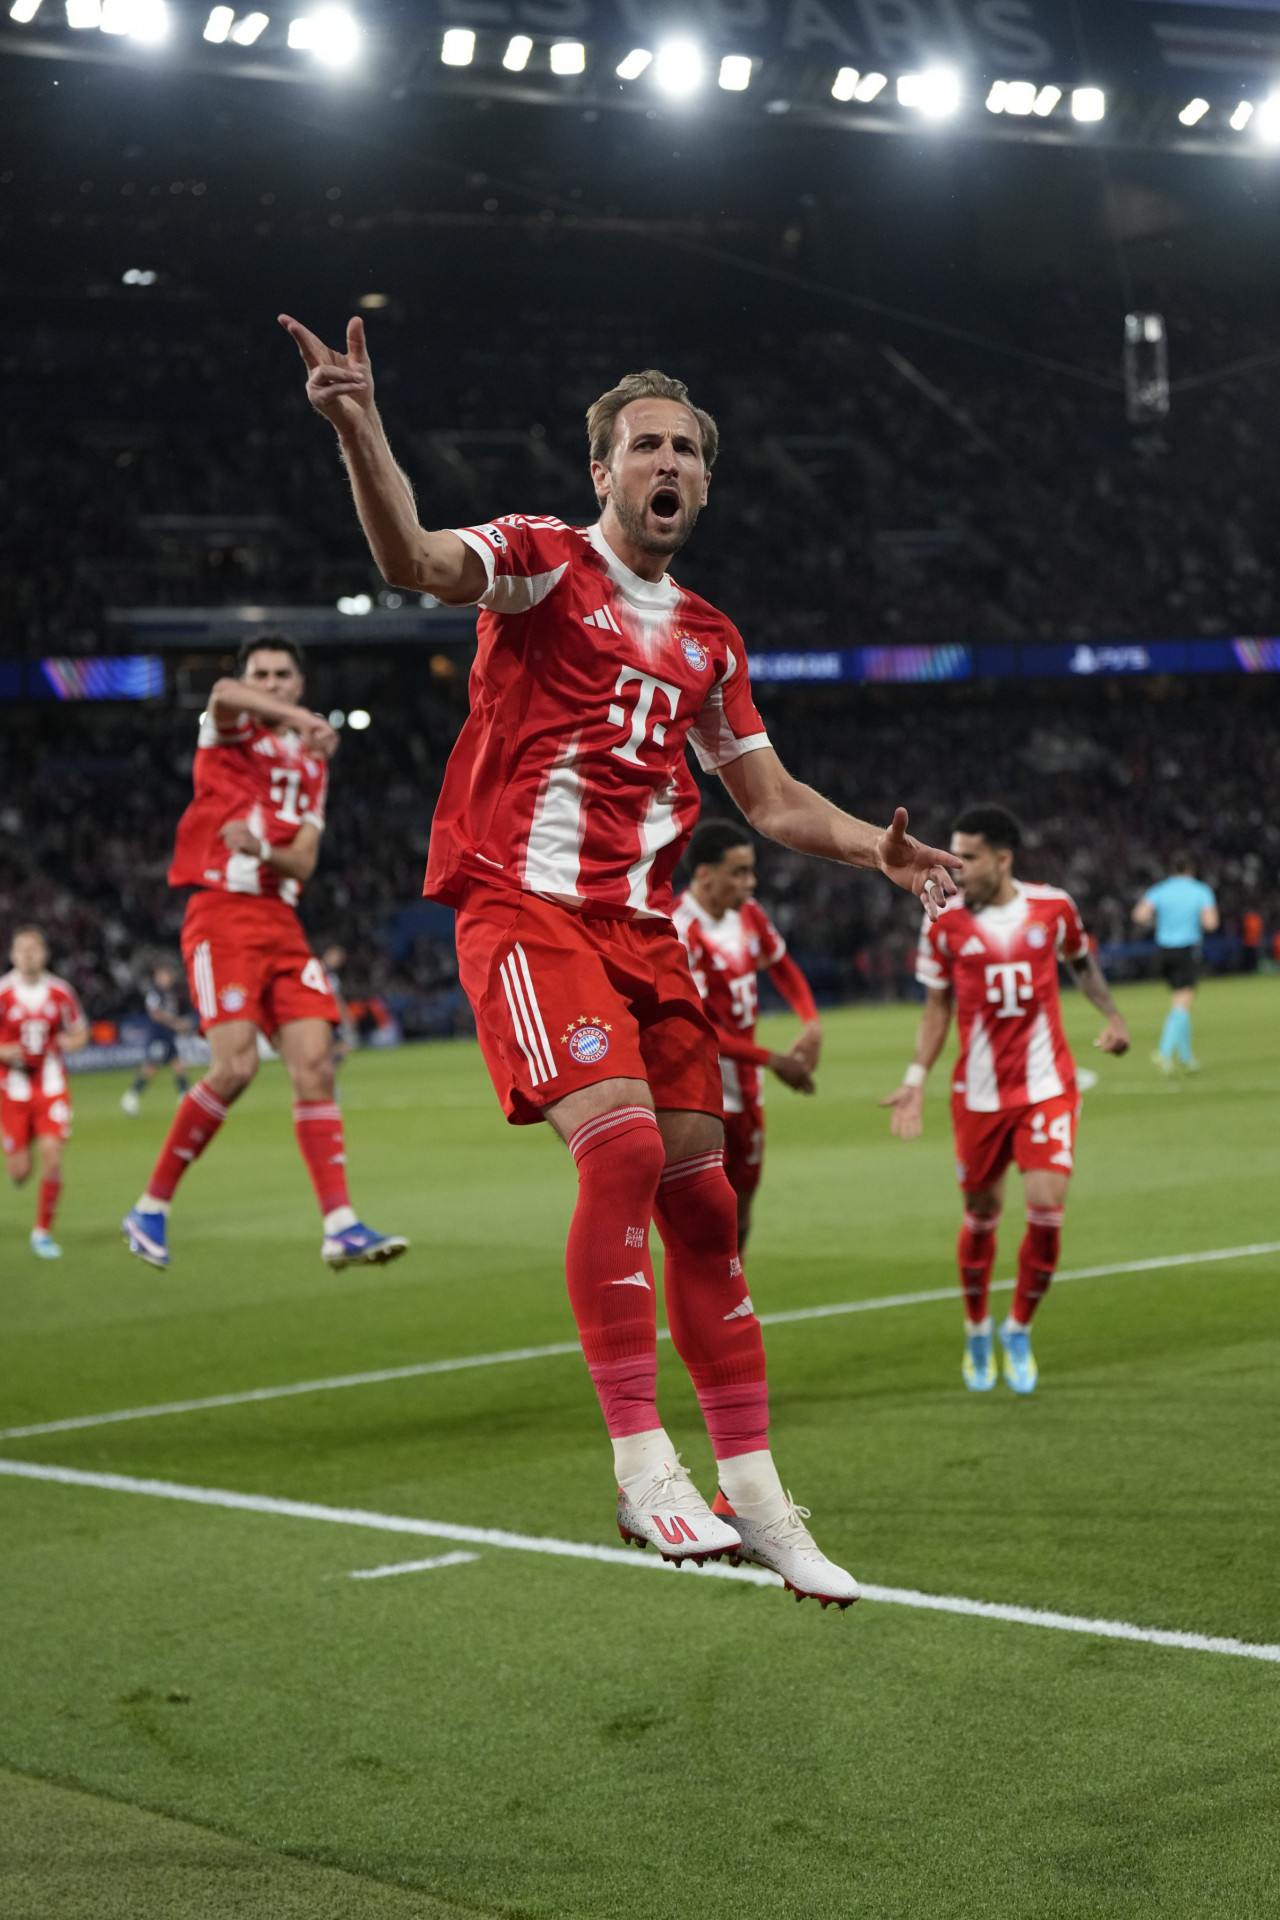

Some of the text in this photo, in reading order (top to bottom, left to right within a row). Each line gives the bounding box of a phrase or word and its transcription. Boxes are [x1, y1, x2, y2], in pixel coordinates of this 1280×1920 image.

[607, 664, 682, 767] T
[269, 767, 309, 825] T
[984, 961, 1033, 1018] T
[577, 1029, 604, 1040] BAYERN
[1031, 1110, 1072, 1150] 14
[625, 1239, 643, 1248] MIA
[626, 1226, 644, 1235] MIA
